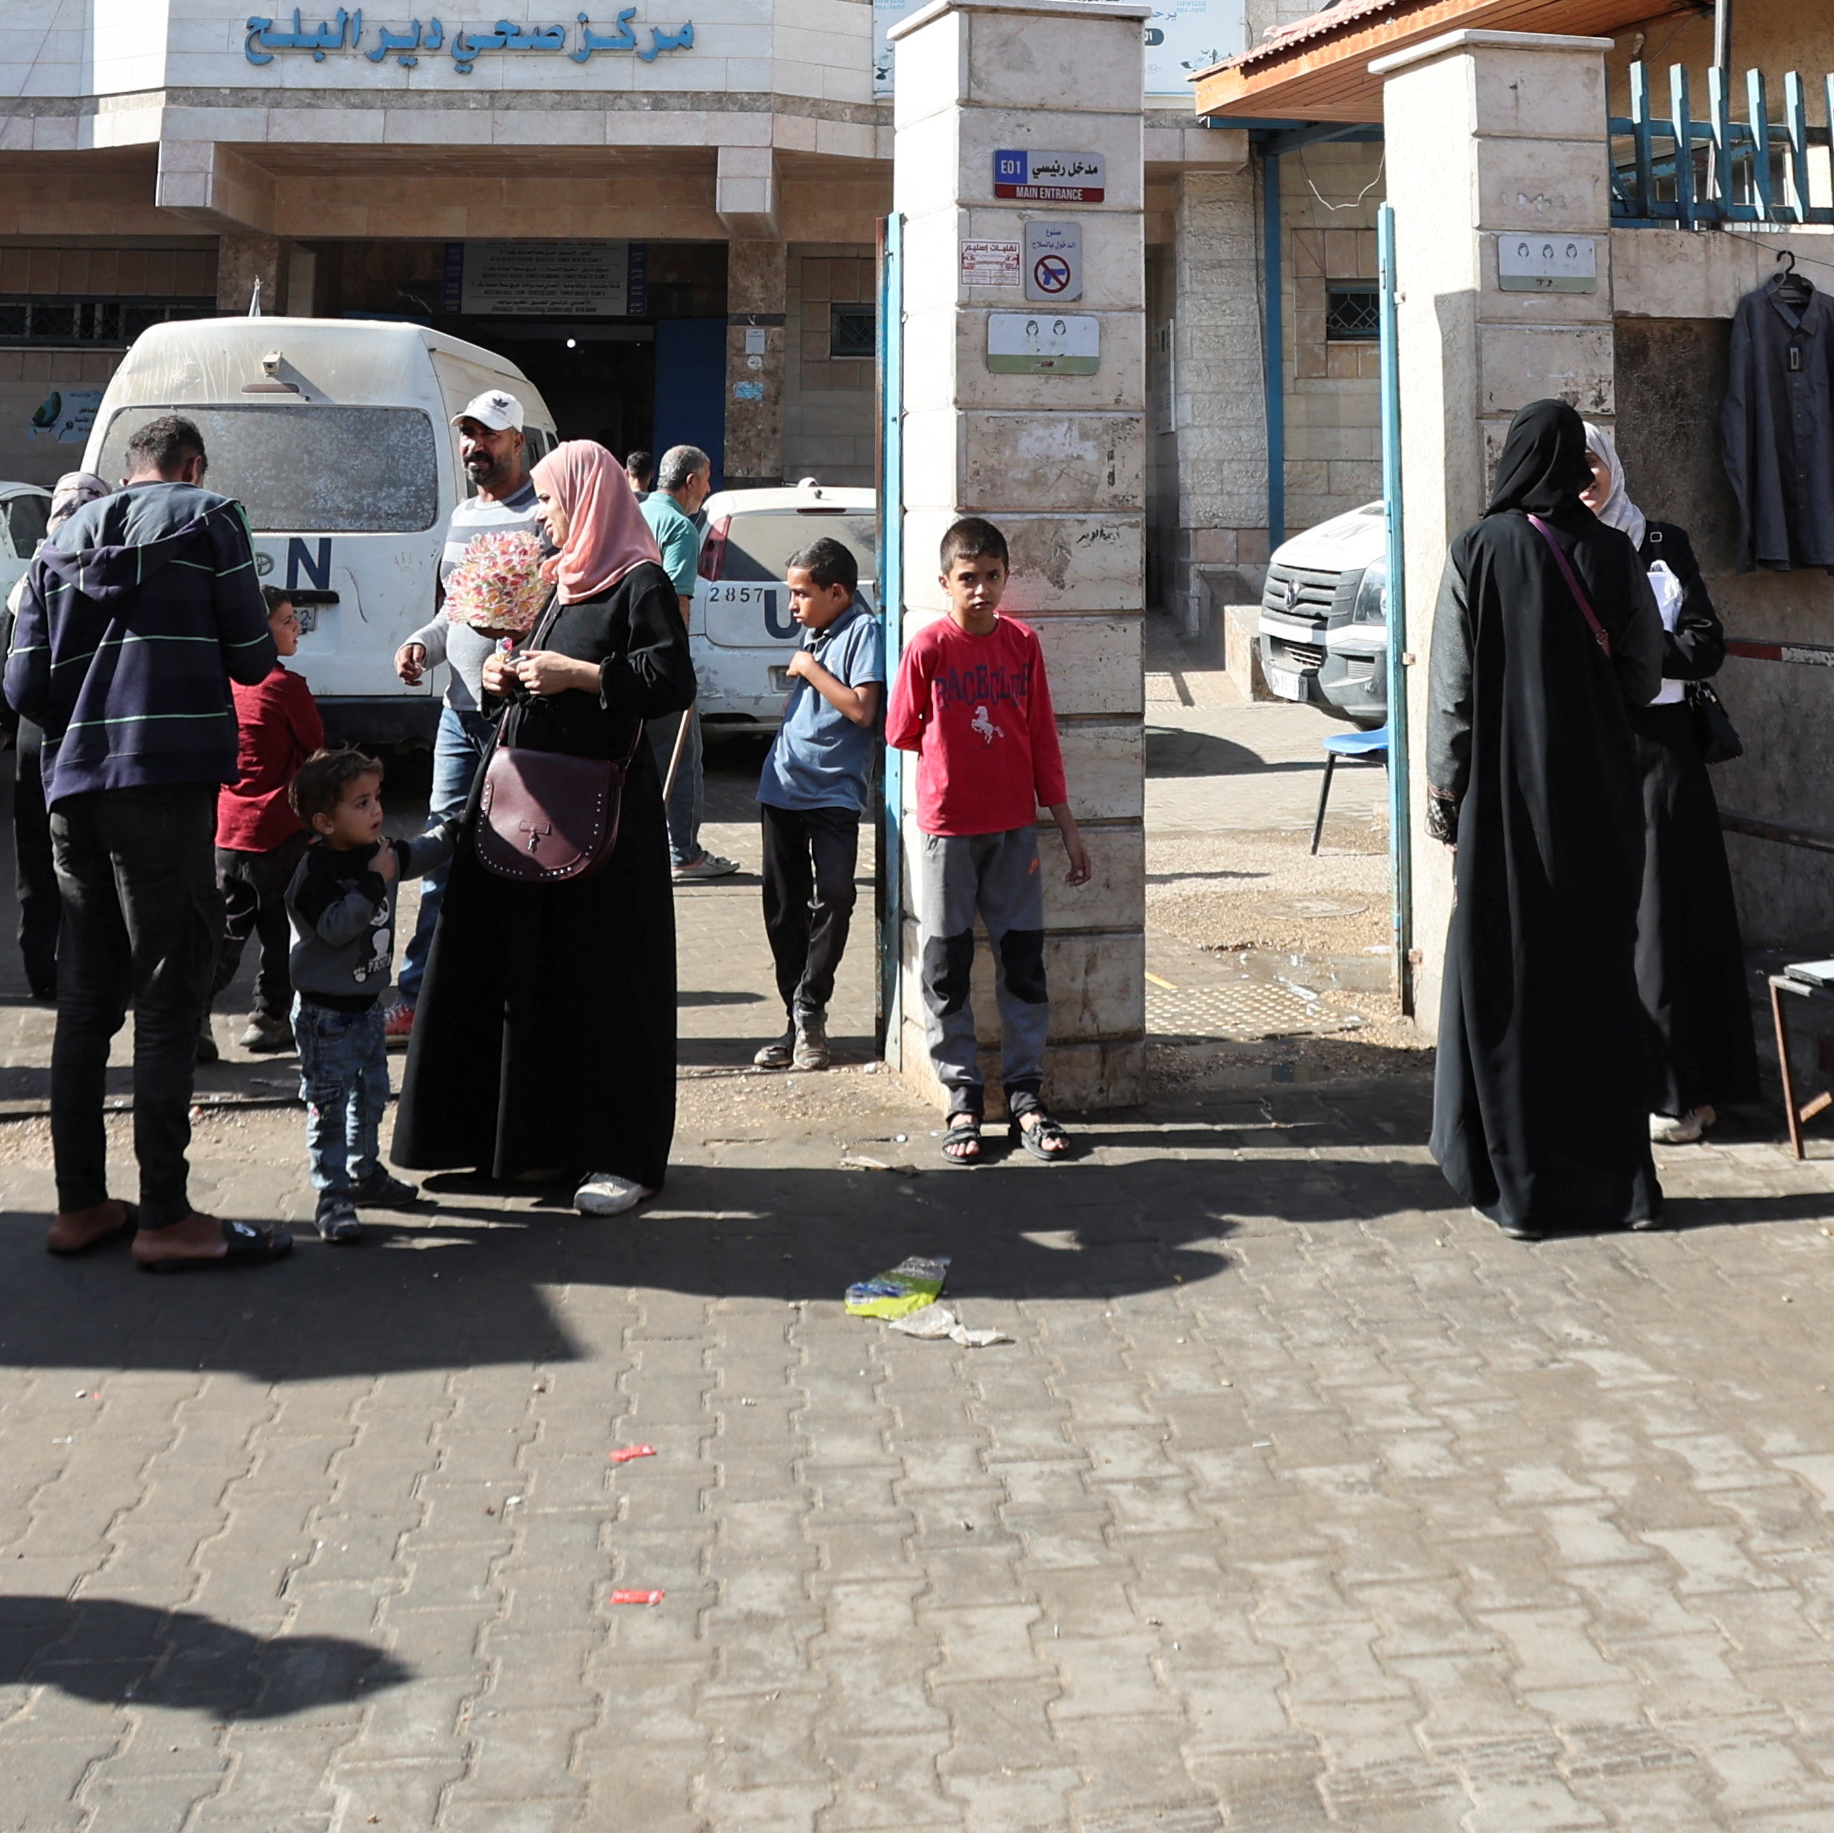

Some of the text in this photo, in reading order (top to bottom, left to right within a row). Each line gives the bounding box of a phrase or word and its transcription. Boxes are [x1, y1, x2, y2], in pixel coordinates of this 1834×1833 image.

[245, 6, 694, 74] مركز صحي دير البلح
[1000, 159, 1021, 175] E01
[1031, 159, 1098, 179] مدخل رئيسي
[1016, 186, 1083, 201] MAIN ENTRANCE
[1046, 228, 1062, 238] ممنوع
[709, 586, 764, 603] 2857
